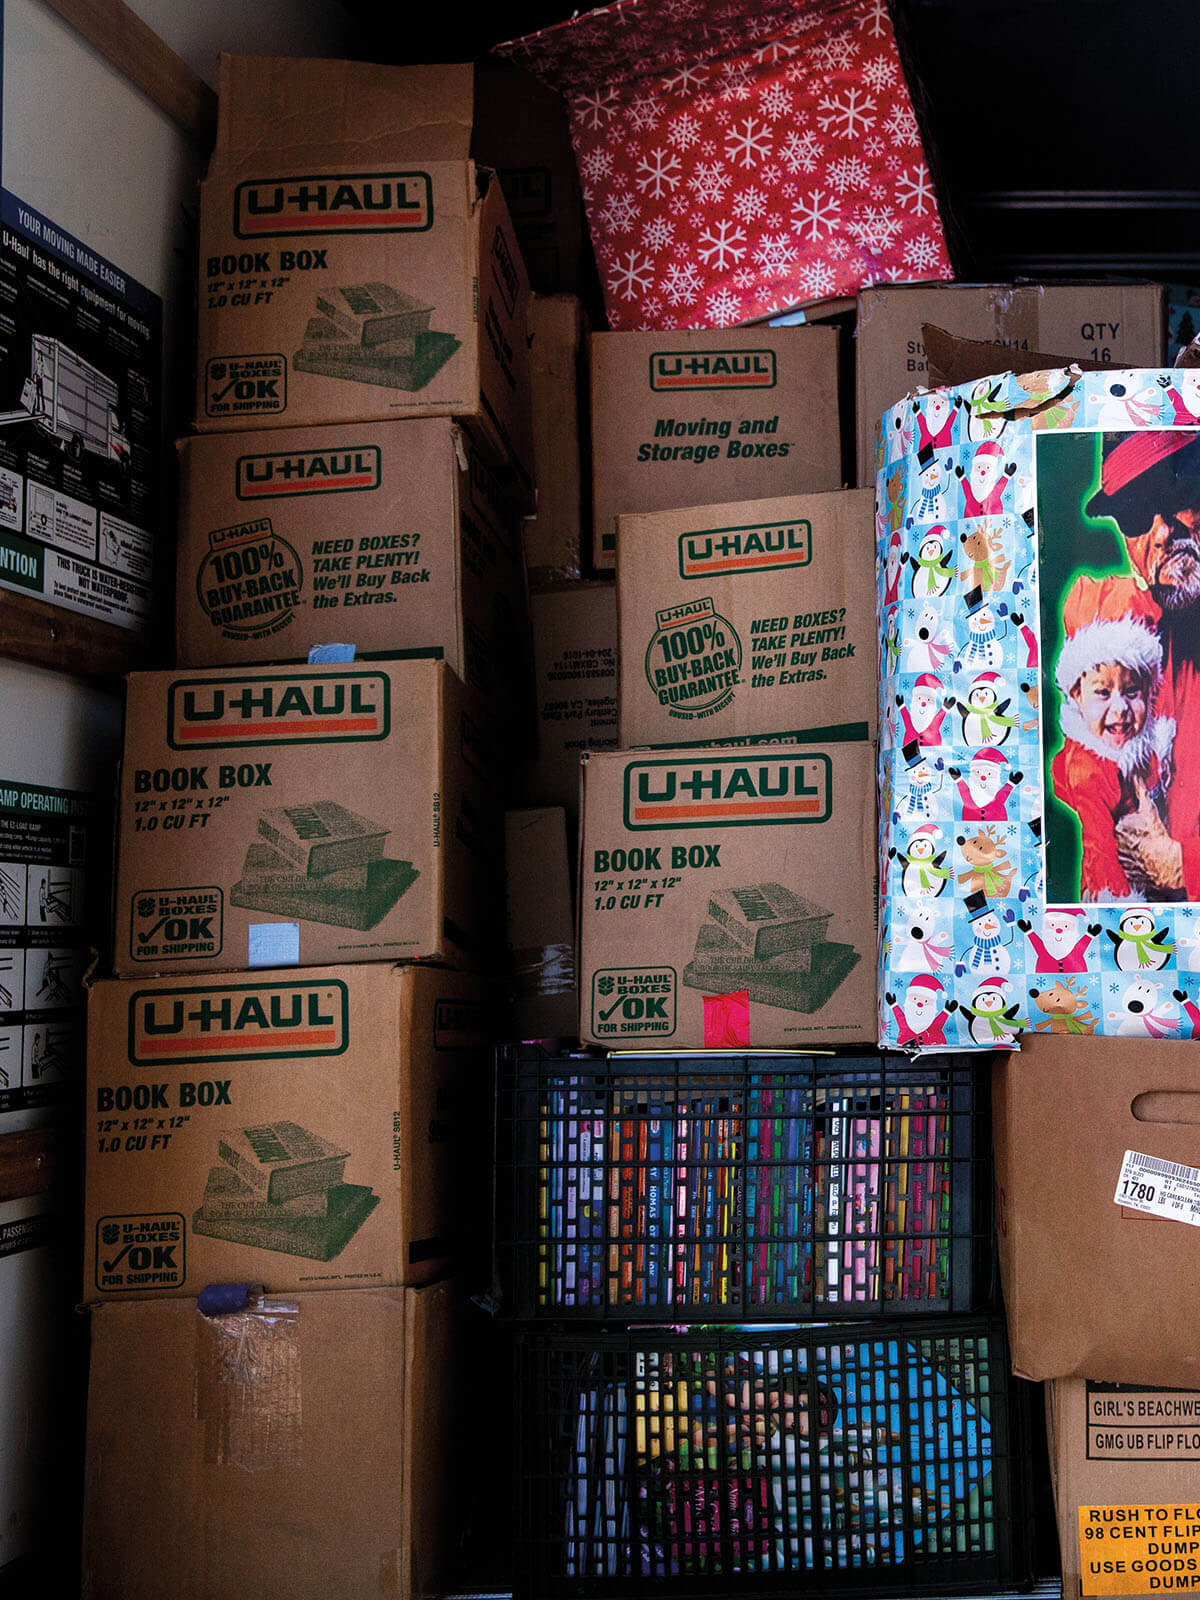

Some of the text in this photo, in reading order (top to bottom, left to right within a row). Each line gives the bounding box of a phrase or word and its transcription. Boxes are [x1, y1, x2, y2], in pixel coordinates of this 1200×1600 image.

[18, 208, 41, 238] YOUR
[42, 226, 75, 258] MOVING
[76, 248, 98, 276] MADE
[100, 263, 126, 294] EASIER
[33, 250, 46, 272] has
[49, 261, 60, 280] the
[62, 270, 79, 292] right
[207, 250, 328, 277] BOOK BOX
[1080, 323, 1120, 340] QTY
[1091, 348, 1111, 362] 16
[654, 416, 779, 439] Moving and
[637, 443, 720, 464] Storage
[57, 556, 70, 571] THIS
[72, 560, 90, 579] TRUCK
[92, 568, 98, 580] IS
[210, 542, 284, 583] 100%
[79, 576, 90, 590] NOT
[206, 569, 296, 609] BUY-BACK
[657, 620, 725, 663] 100%
[655, 648, 737, 687] BUY-BACK
[134, 763, 272, 794] BOOK BOX
[20, 791, 69, 813] OPERATING
[594, 845, 721, 872] BOOK BOX
[594, 894, 664, 910] 1.0 CU FT
[622, 998, 669, 1019] OK
[598, 1022, 669, 1033] FOR SHIPPING
[97, 1080, 232, 1112] BOOK BOX
[1123, 1180, 1155, 1201] 1780
[1093, 1400, 1135, 1417] GIRL'S
[1095, 1434, 1124, 1449] GMG
[1127, 1434, 1144, 1449] UB
[1147, 1434, 1174, 1449] FLIP
[1089, 1509, 1139, 1522] RUSH
[1144, 1508, 1169, 1522] TO
[1085, 1527, 1105, 1540] 98
[1109, 1526, 1158, 1539] CENT
[1148, 1542, 1200, 1555] DUMP
[1090, 1561, 1126, 1574] USE
[1131, 1558, 1198, 1573] GOODS
[1150, 1575, 1200, 1589] DUMP
